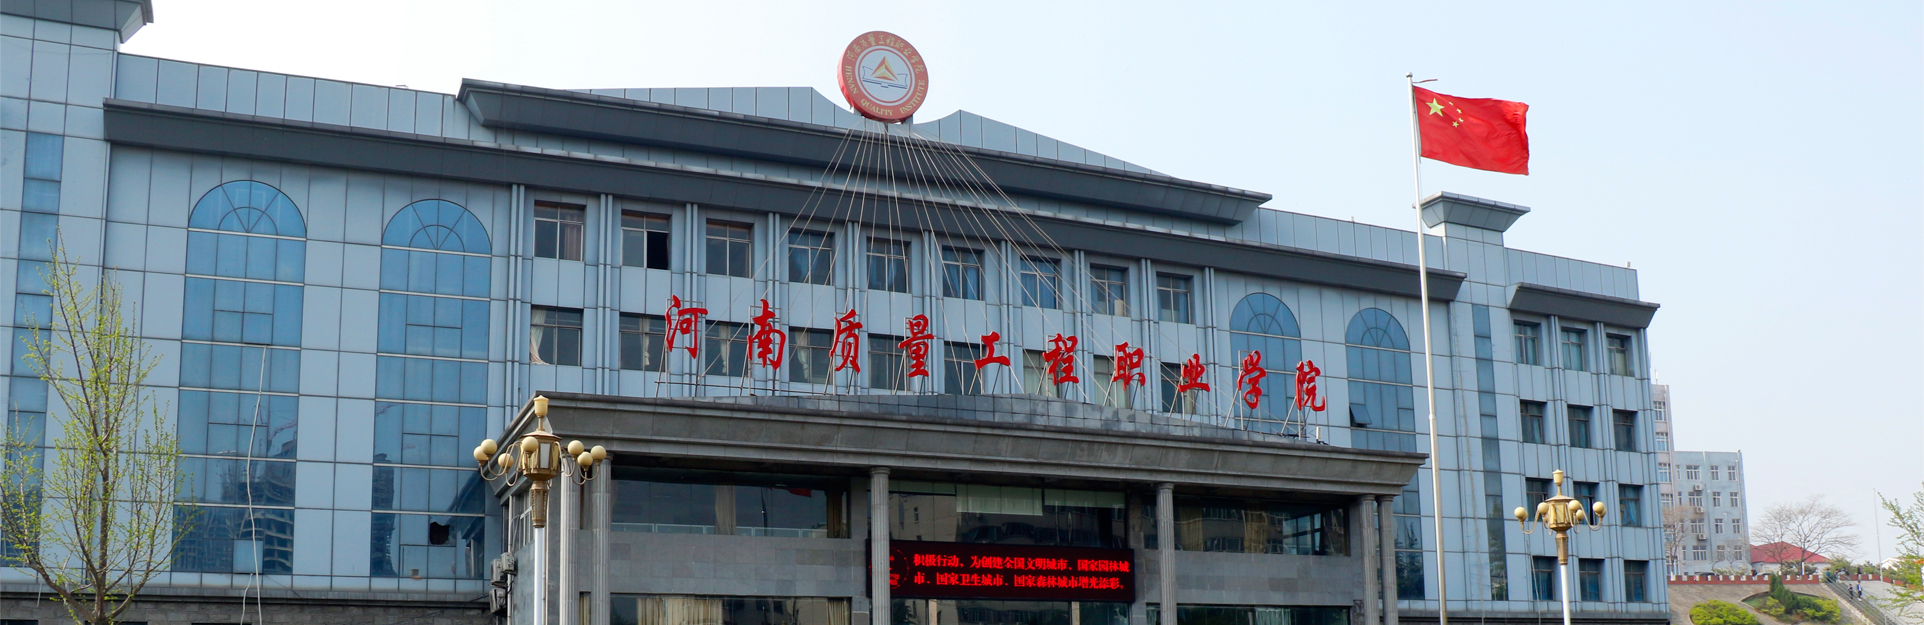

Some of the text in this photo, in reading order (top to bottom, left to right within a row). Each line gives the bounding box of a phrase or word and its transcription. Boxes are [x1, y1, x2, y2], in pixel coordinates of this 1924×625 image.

[845, 65, 925, 116] HENAN QUALITY INSTITUTE
[665, 294, 1326, 412] 河南质量工程职业学院
